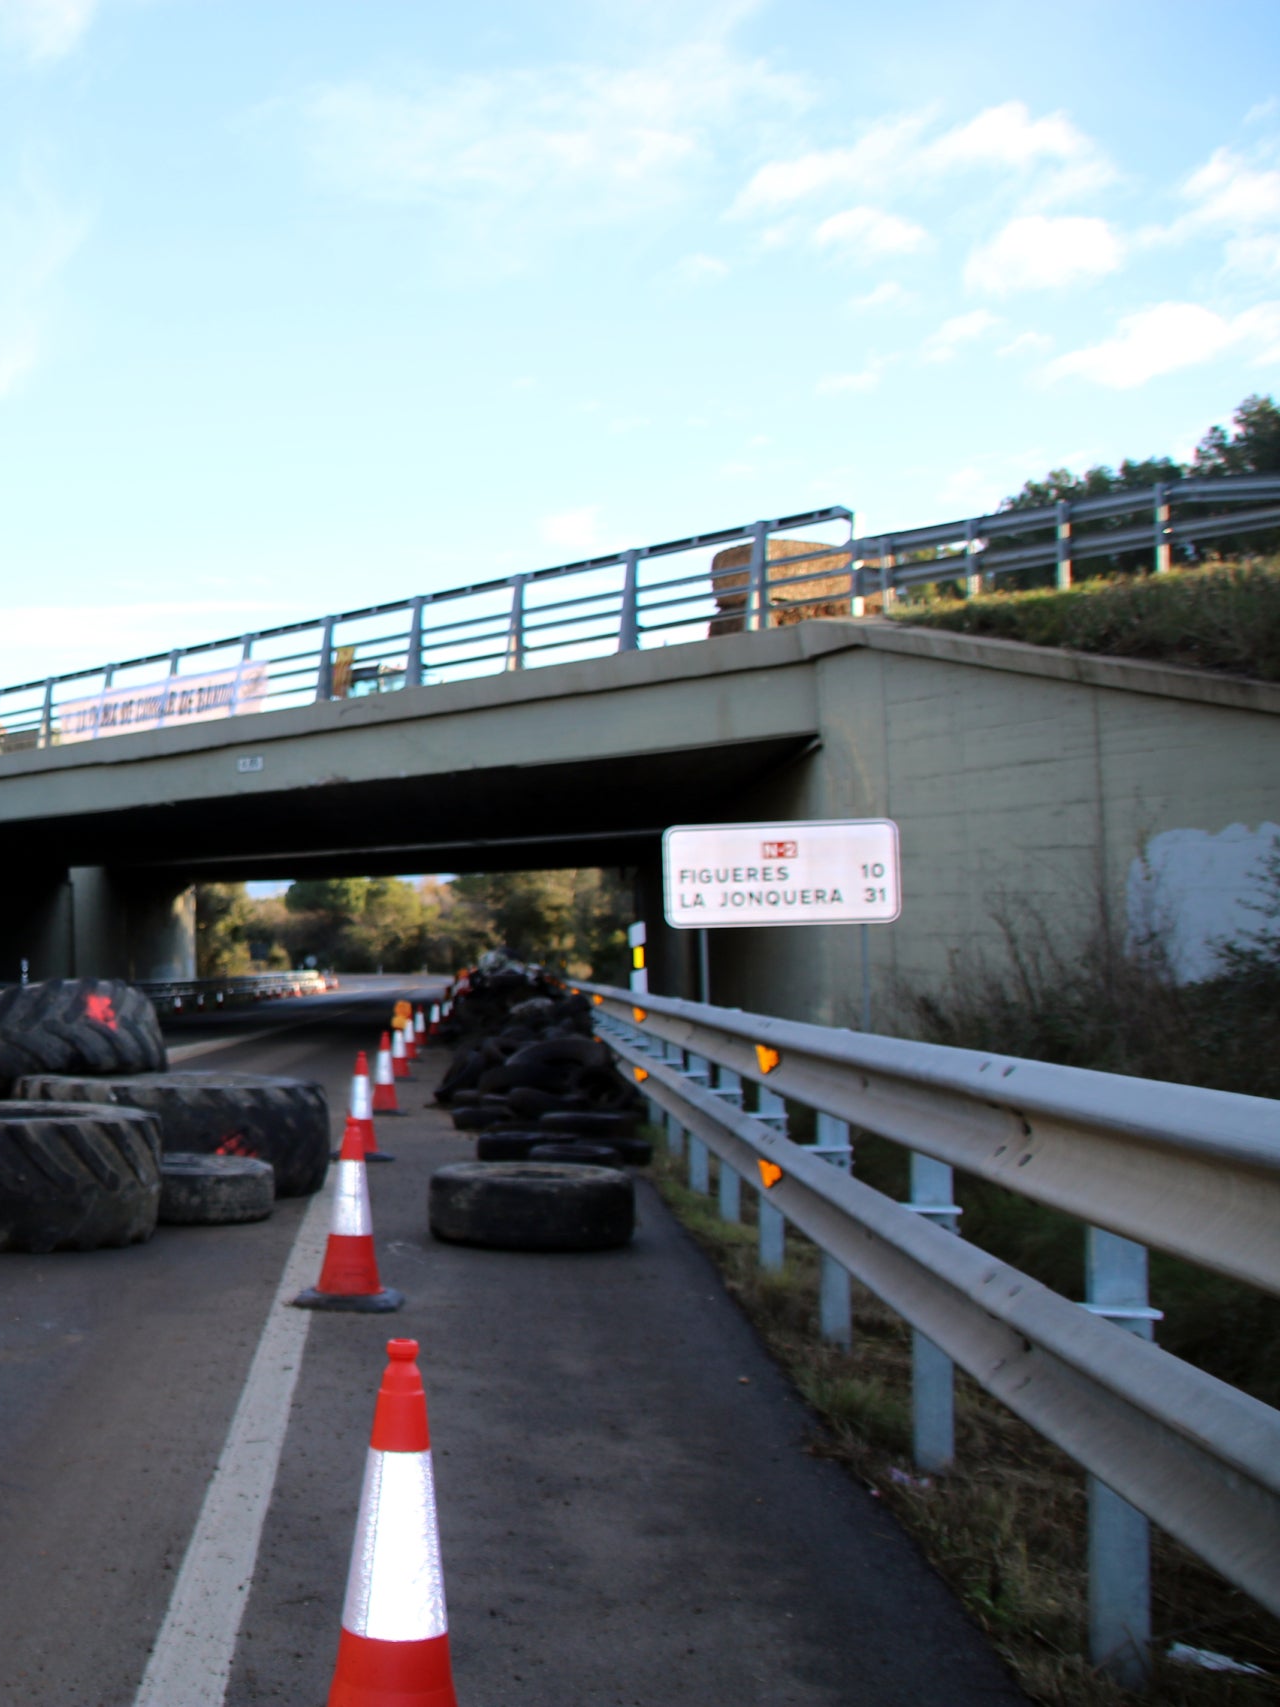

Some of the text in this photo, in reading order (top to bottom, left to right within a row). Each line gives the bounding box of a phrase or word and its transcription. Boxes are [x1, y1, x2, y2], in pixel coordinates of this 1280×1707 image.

[764, 843, 797, 858] N-2
[679, 863, 886, 884] FIGUERES 10
[680, 887, 887, 909] LA JONQUERA 31
